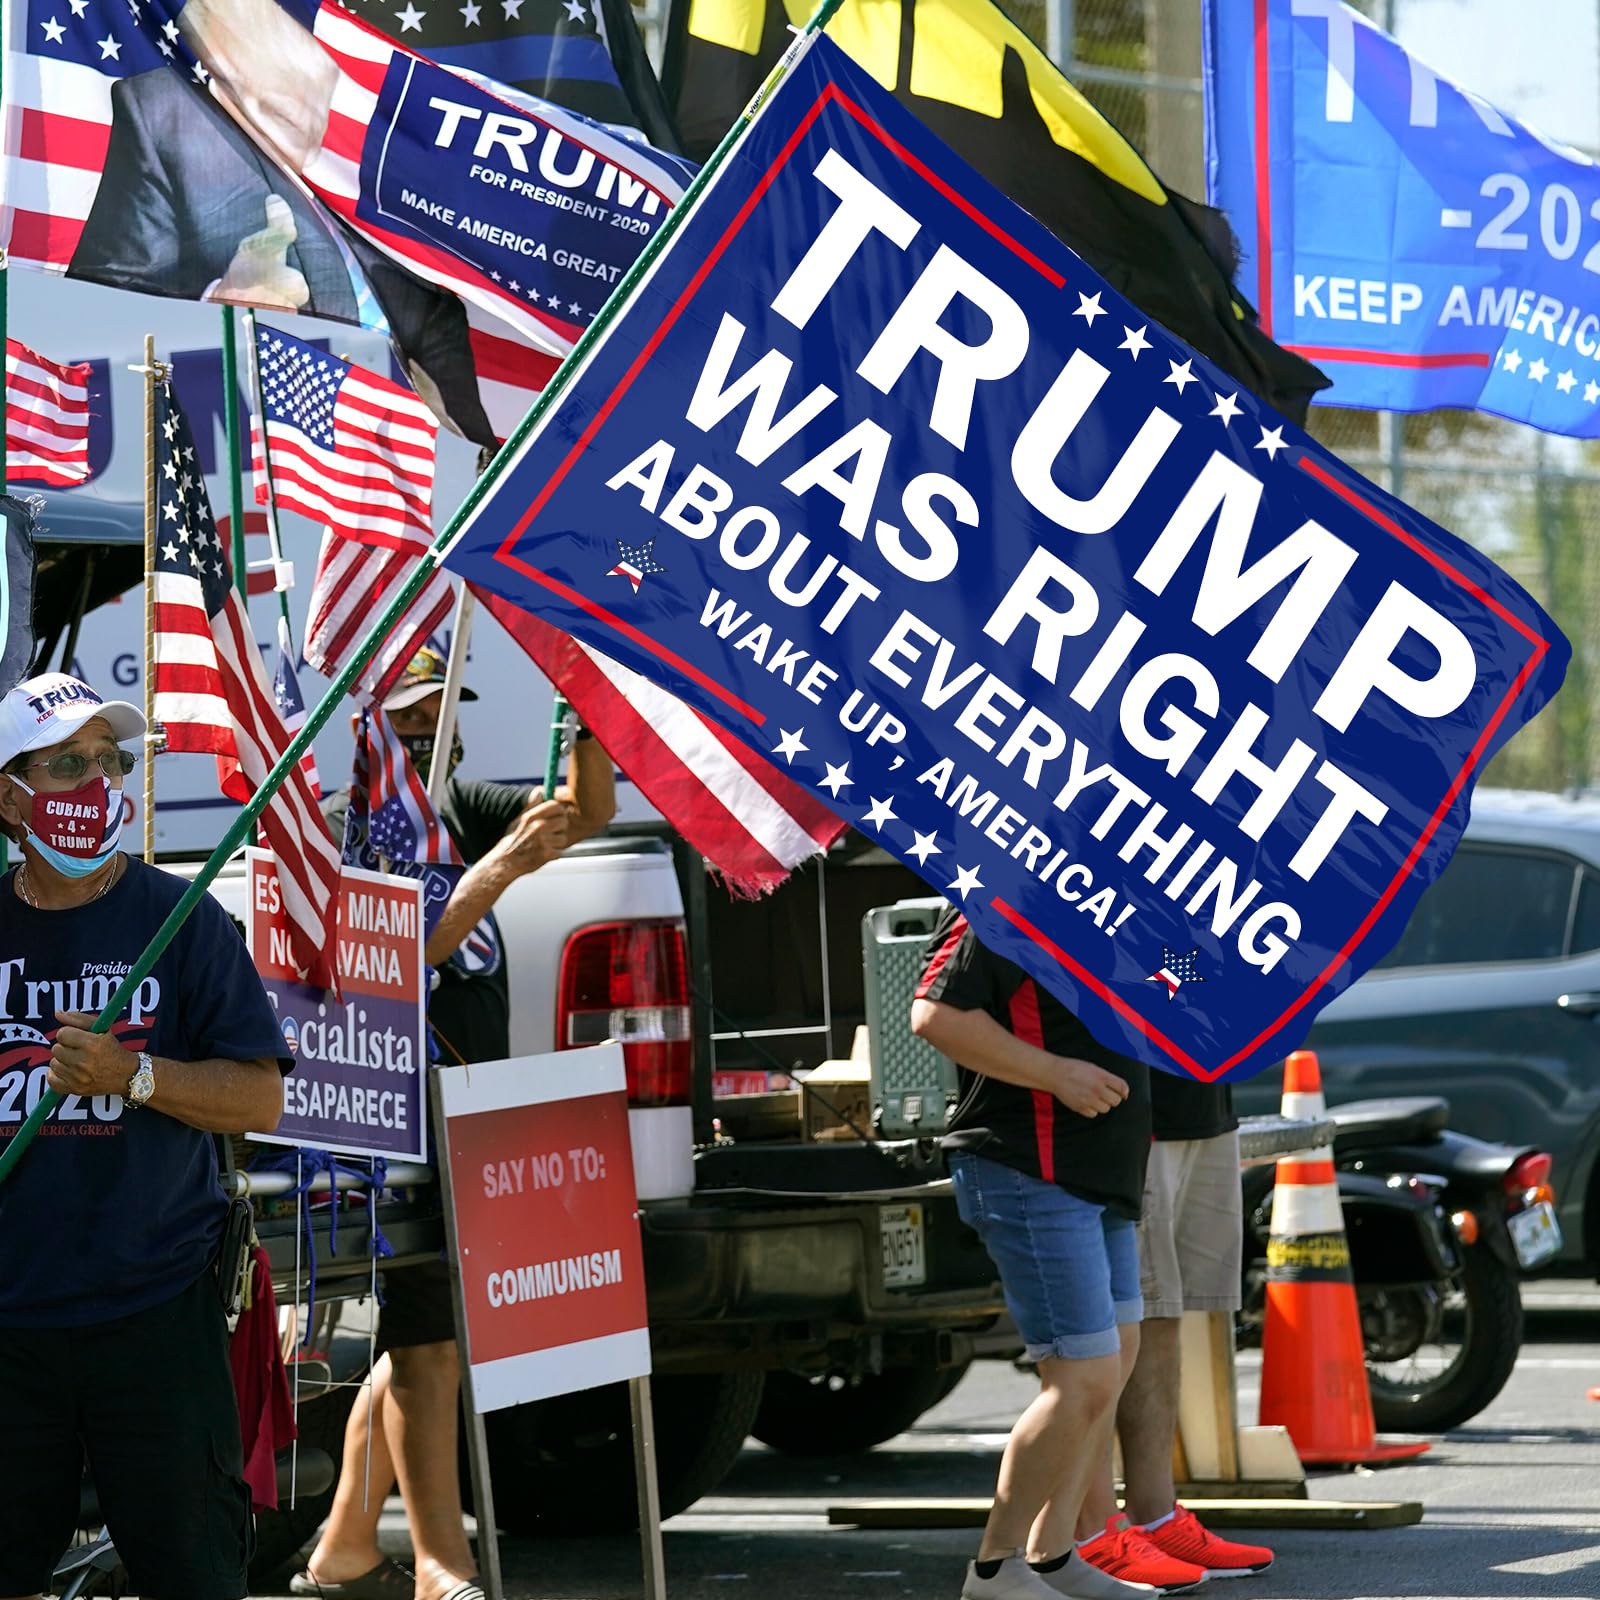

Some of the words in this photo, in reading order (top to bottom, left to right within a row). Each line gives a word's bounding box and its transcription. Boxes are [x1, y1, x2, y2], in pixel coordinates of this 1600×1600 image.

[428, 96, 675, 216] TRUM
[469, 164, 506, 188] FOR
[509, 180, 607, 222] PRESIDENT
[609, 212, 651, 236] 2020
[400, 189, 456, 226] MAKE
[457, 216, 548, 261] AMERICA
[551, 249, 622, 284] GREAT
[1294, 274, 1423, 325] KEEP
[1437, 284, 1600, 360] AMERIC
[769, 148, 1476, 733] TRUMP
[686, 312, 978, 581] WAS
[983, 546, 1389, 881] RIGHT
[28, 683, 104, 714] TRUM
[606, 440, 880, 634] ABOUT
[870, 610, 1302, 974] EVERYTHING
[700, 589, 839, 704] WAKE
[840, 689, 907, 770] UP,
[917, 758, 1136, 938] AMERICA!
[46, 800, 100, 820] CUBANS
[50, 833, 96, 850] TRUMP
[67, 821, 76, 833] 4
[255, 873, 287, 916] ES
[348, 891, 416, 939] MIAMI
[80, 961, 133, 977] Preside
[337, 939, 403, 987] VANA
[266, 991, 416, 1076] ocialista
[36, 1124, 77, 1137] ERICA
[283, 1077, 408, 1131] ESAPARECE
[482, 1158, 526, 1199] SAY
[532, 1152, 565, 1190] NO
[568, 1146, 607, 1183] TO:
[486, 1249, 623, 1309] COMMUNISM
